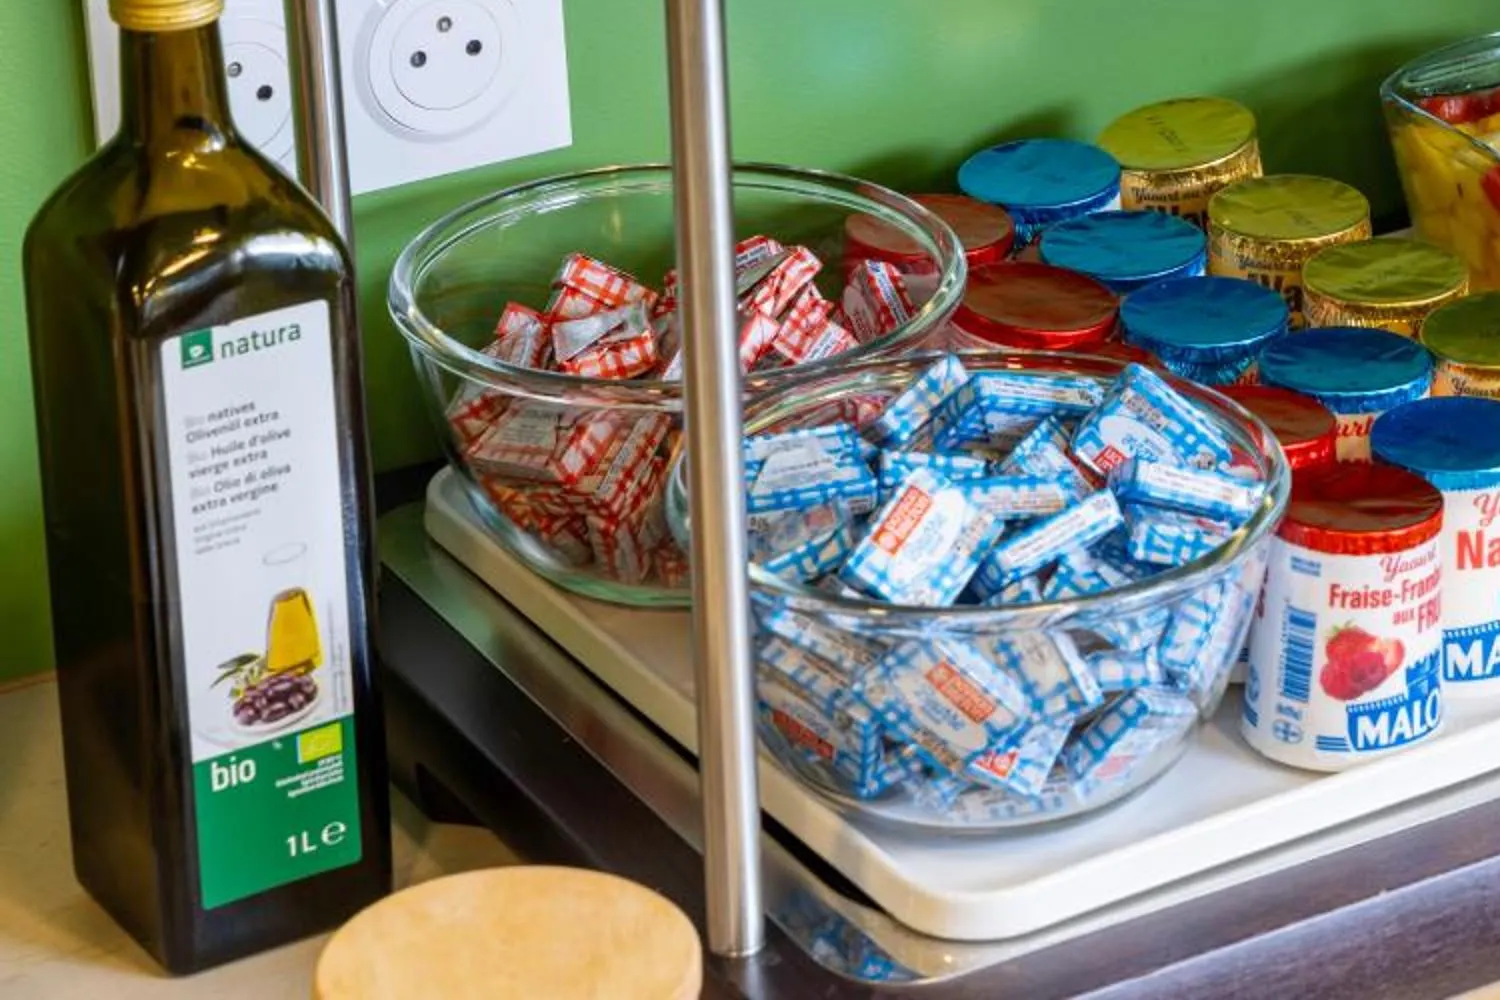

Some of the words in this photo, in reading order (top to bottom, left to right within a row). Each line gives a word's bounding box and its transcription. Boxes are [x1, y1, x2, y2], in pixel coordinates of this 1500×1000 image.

[220, 323, 301, 359] natura
[207, 401, 256, 422] natives
[244, 411, 280, 428] extra
[210, 440, 246, 460] Huile
[188, 461, 229, 479] vierge
[233, 450, 268, 467] extra
[260, 463, 292, 481] oliva
[191, 497, 228, 514] extra
[229, 483, 278, 503] vergine
[1392, 607, 1415, 626] aux
[1356, 688, 1440, 750] MALO
[210, 755, 257, 793] bio
